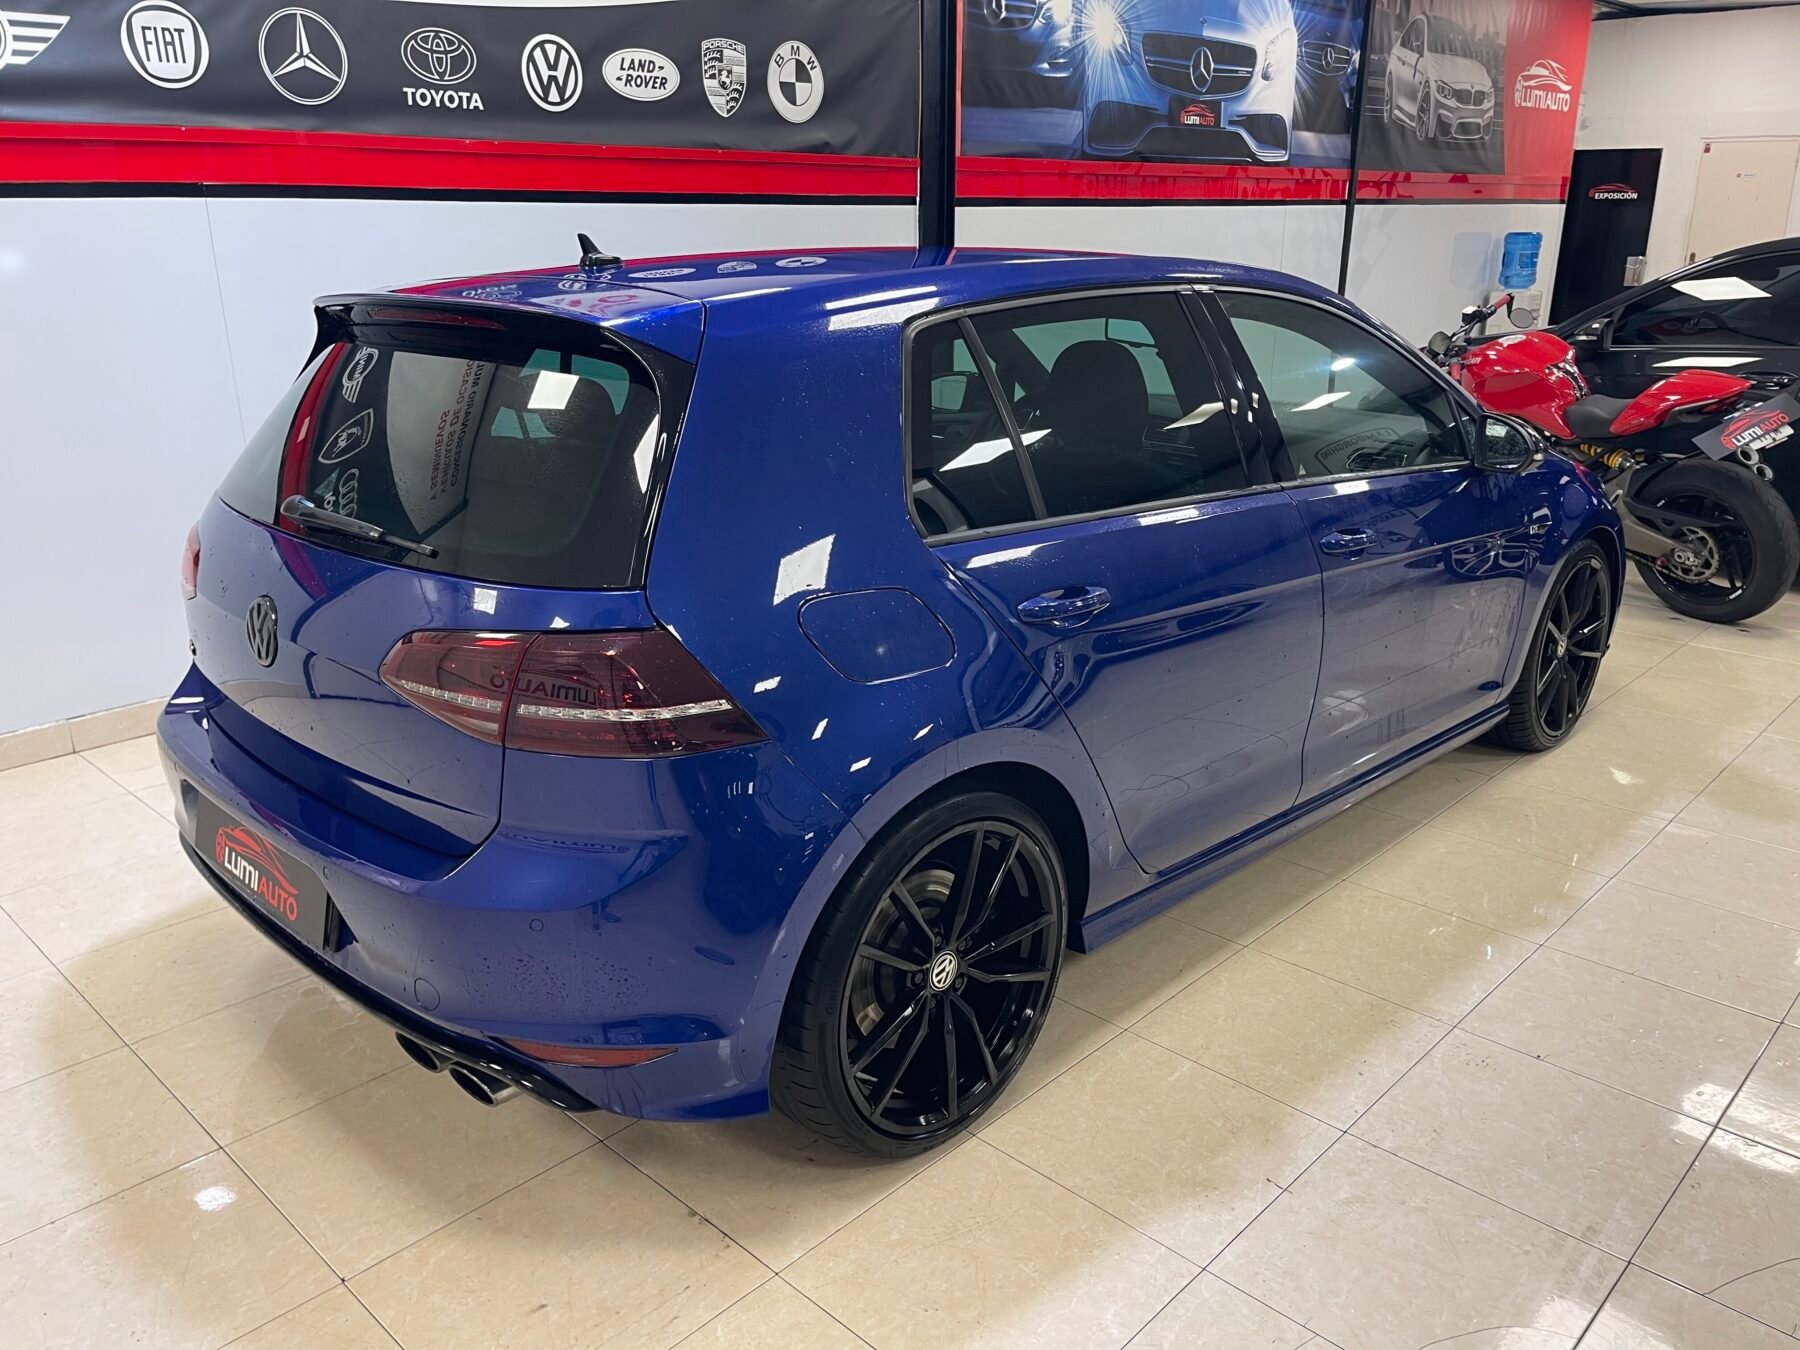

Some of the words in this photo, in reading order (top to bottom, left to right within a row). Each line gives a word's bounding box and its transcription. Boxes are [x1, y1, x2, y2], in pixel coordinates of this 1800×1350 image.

[140, 25, 187, 64] FIAT
[703, 40, 746, 54] PORSCHE
[402, 87, 485, 111] TOYOTA
[1594, 191, 1639, 200] EXPOSICIÓN
